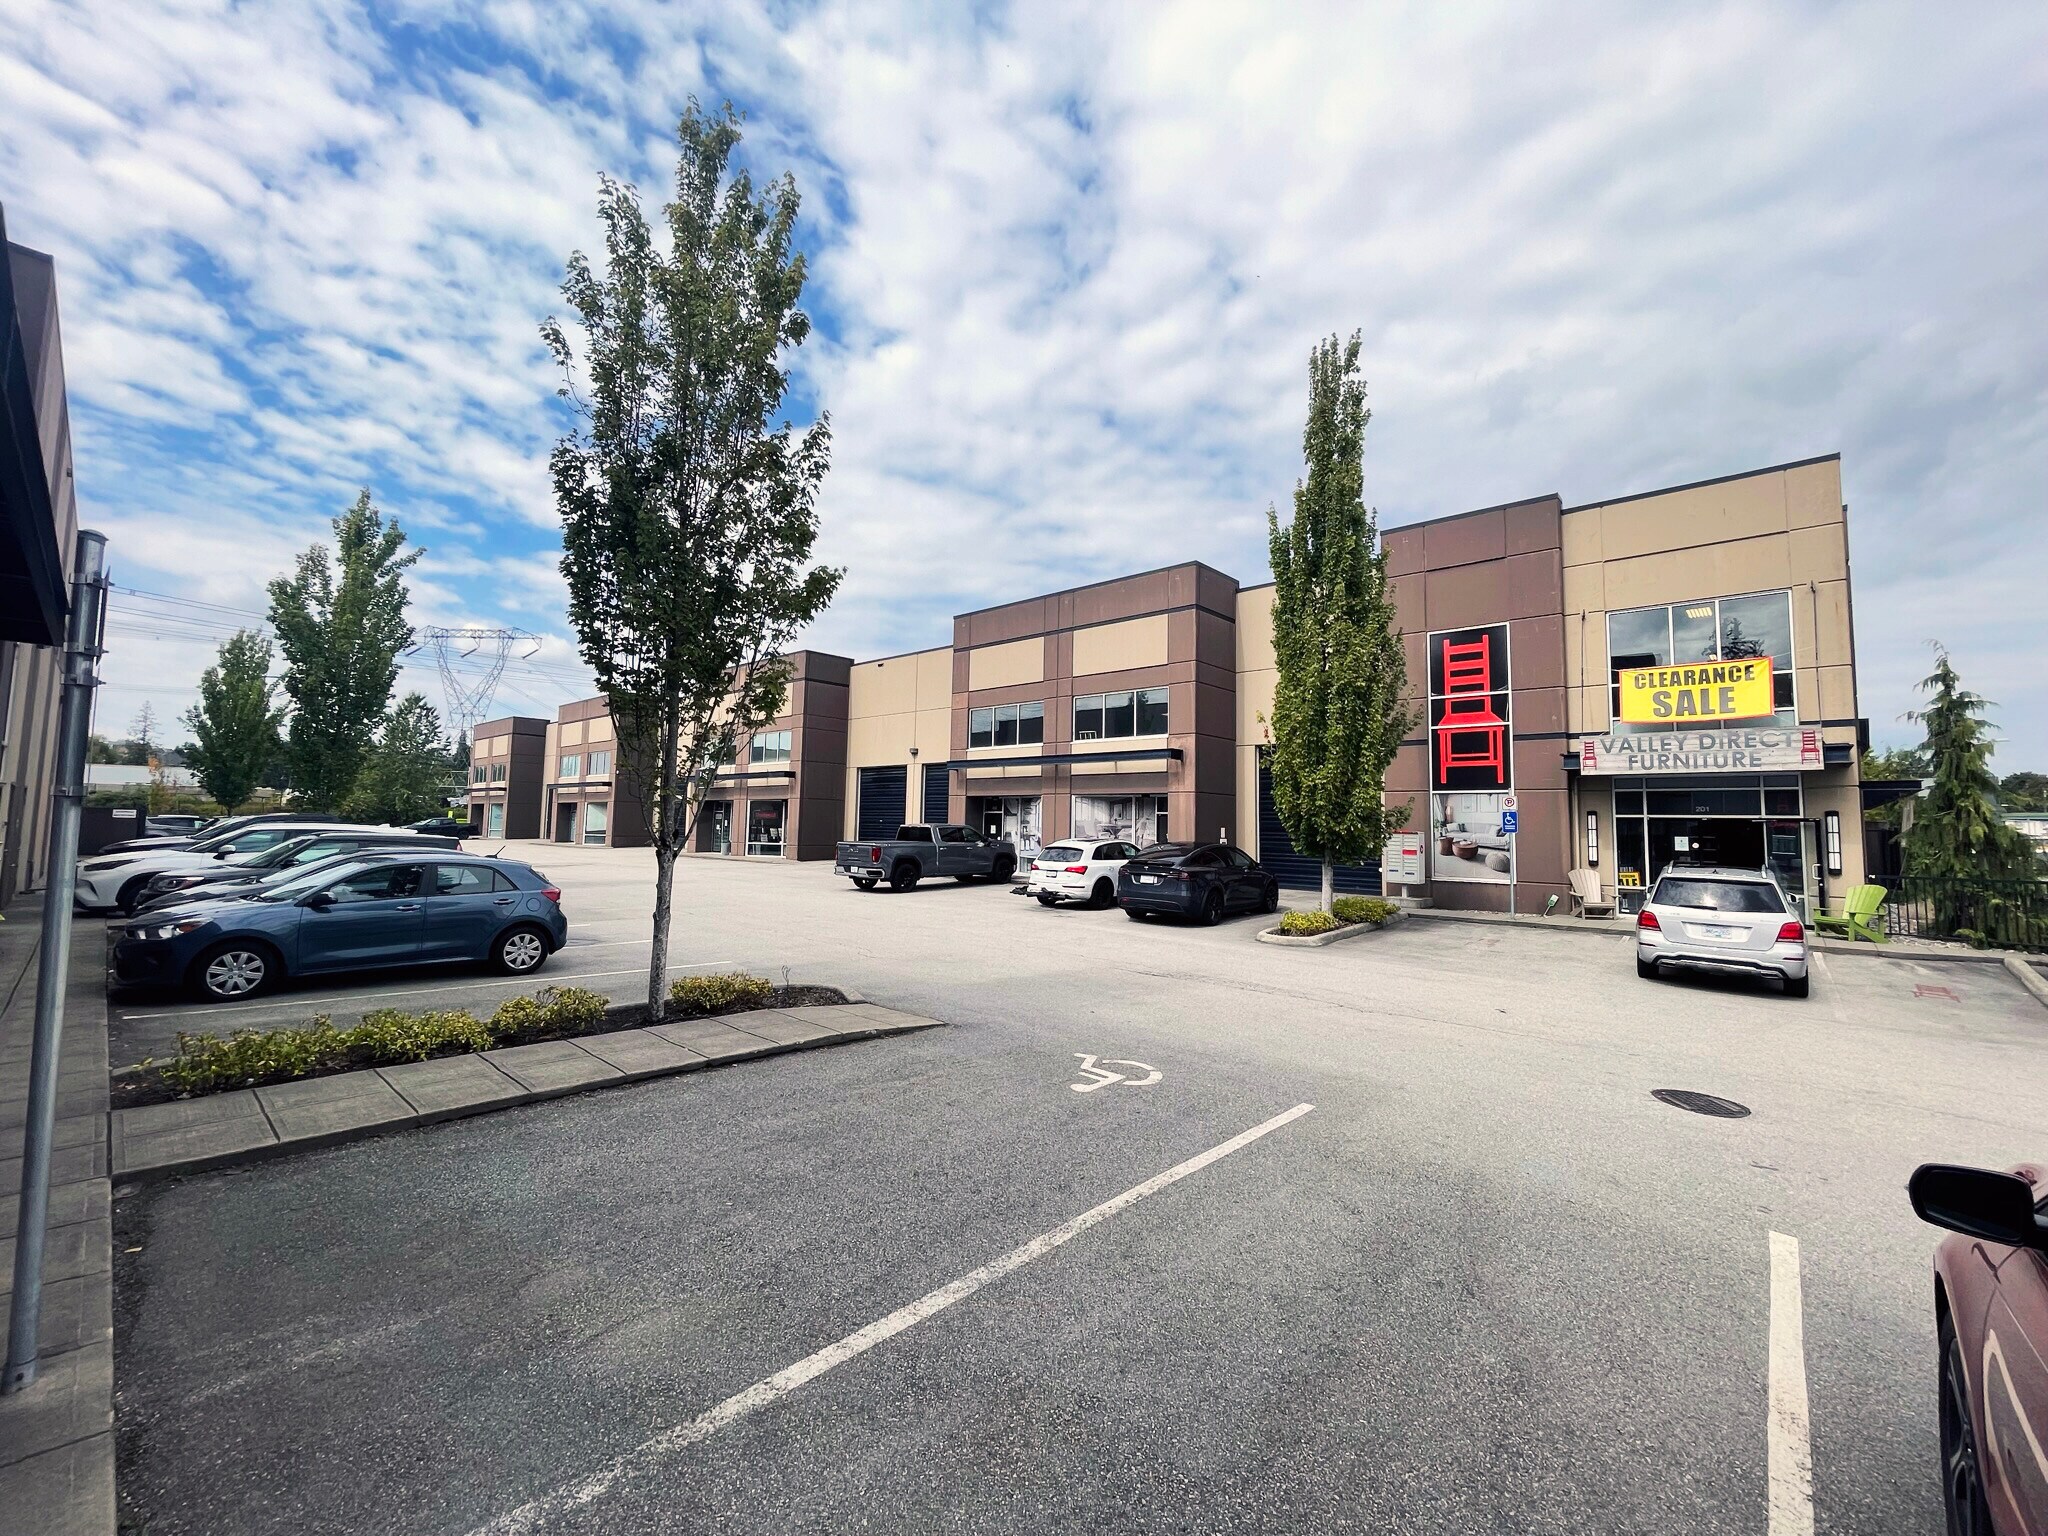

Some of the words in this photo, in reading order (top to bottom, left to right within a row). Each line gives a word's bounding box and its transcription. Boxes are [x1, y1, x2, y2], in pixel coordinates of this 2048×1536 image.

[1634, 664, 1756, 689] CLEARANCE
[1652, 686, 1736, 717] SALE
[1599, 734, 1688, 754] VALLEY
[1698, 730, 1793, 750] DIRECT
[1628, 751, 1762, 771] FURNITURE
[1617, 878, 1638, 887] ALE
